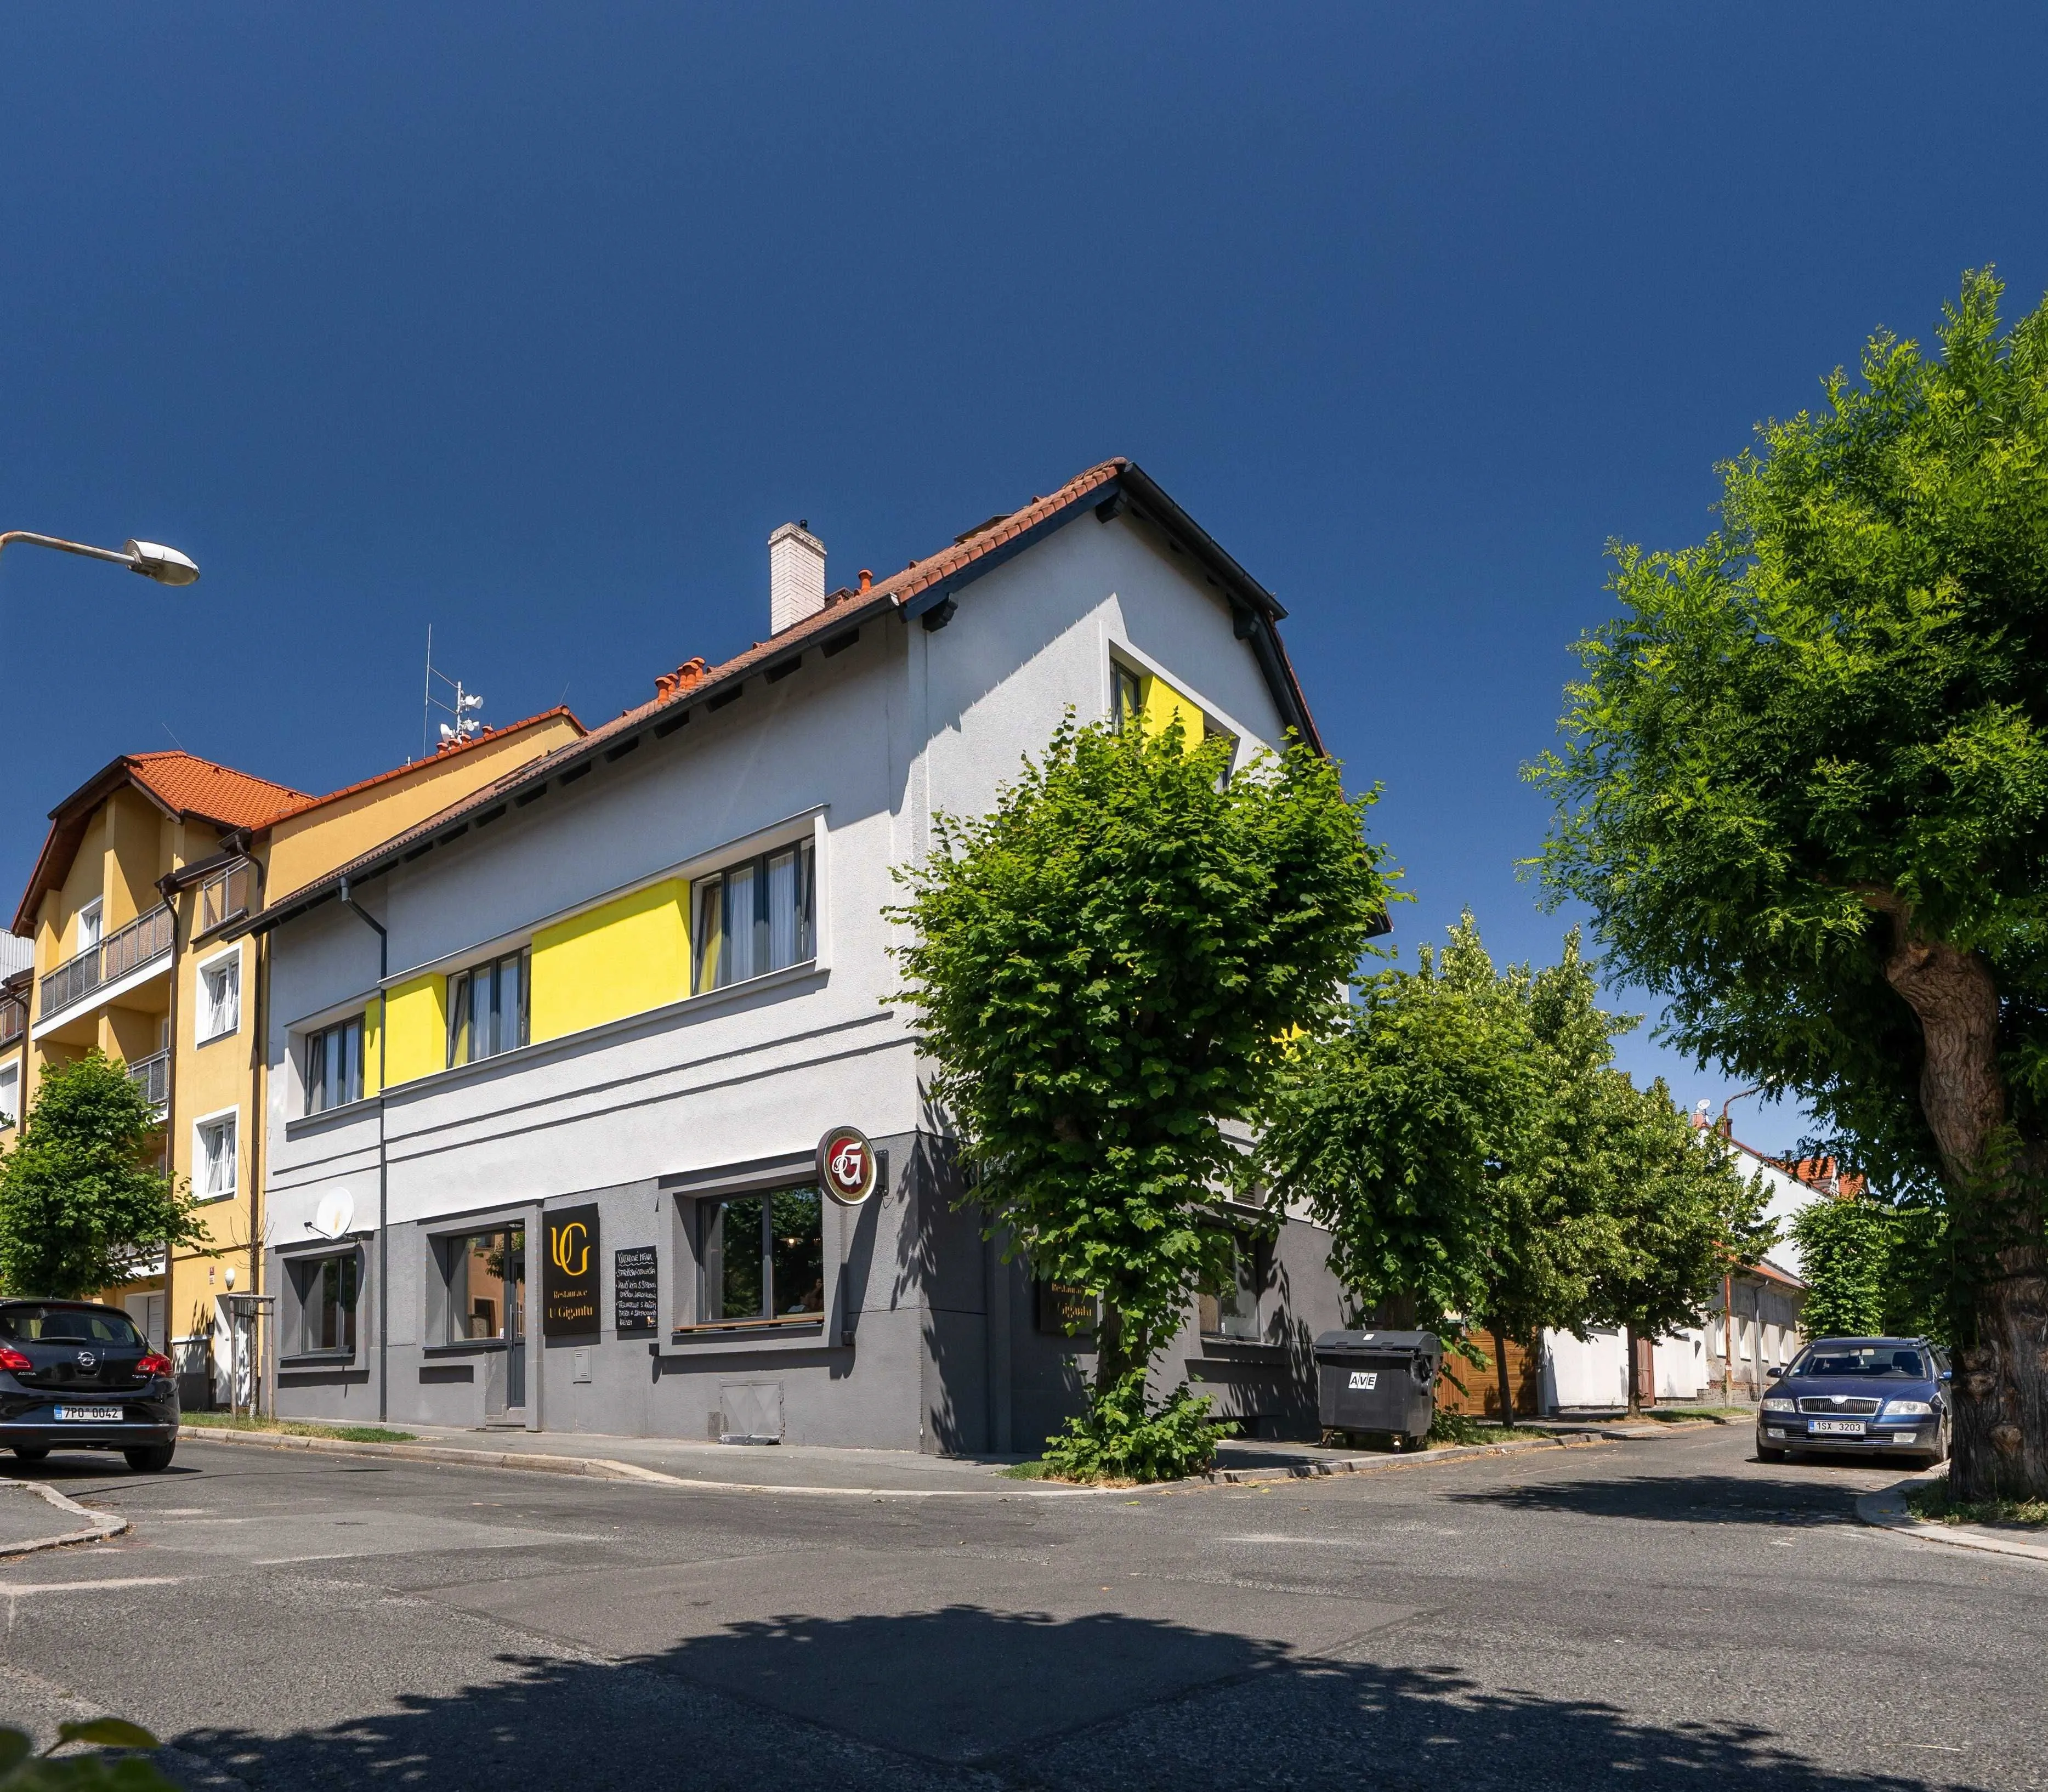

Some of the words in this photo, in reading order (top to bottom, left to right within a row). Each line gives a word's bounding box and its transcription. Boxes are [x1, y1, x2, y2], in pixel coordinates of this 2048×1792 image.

[553, 1290, 588, 1299] Restaurace
[558, 1305, 593, 1320] Gigantu
[1350, 1376, 1375, 1386] AVE
[92, 1408, 118, 1419] 0042
[1816, 1422, 1832, 1431] 1SX
[1839, 1423, 1860, 1432] 3203
